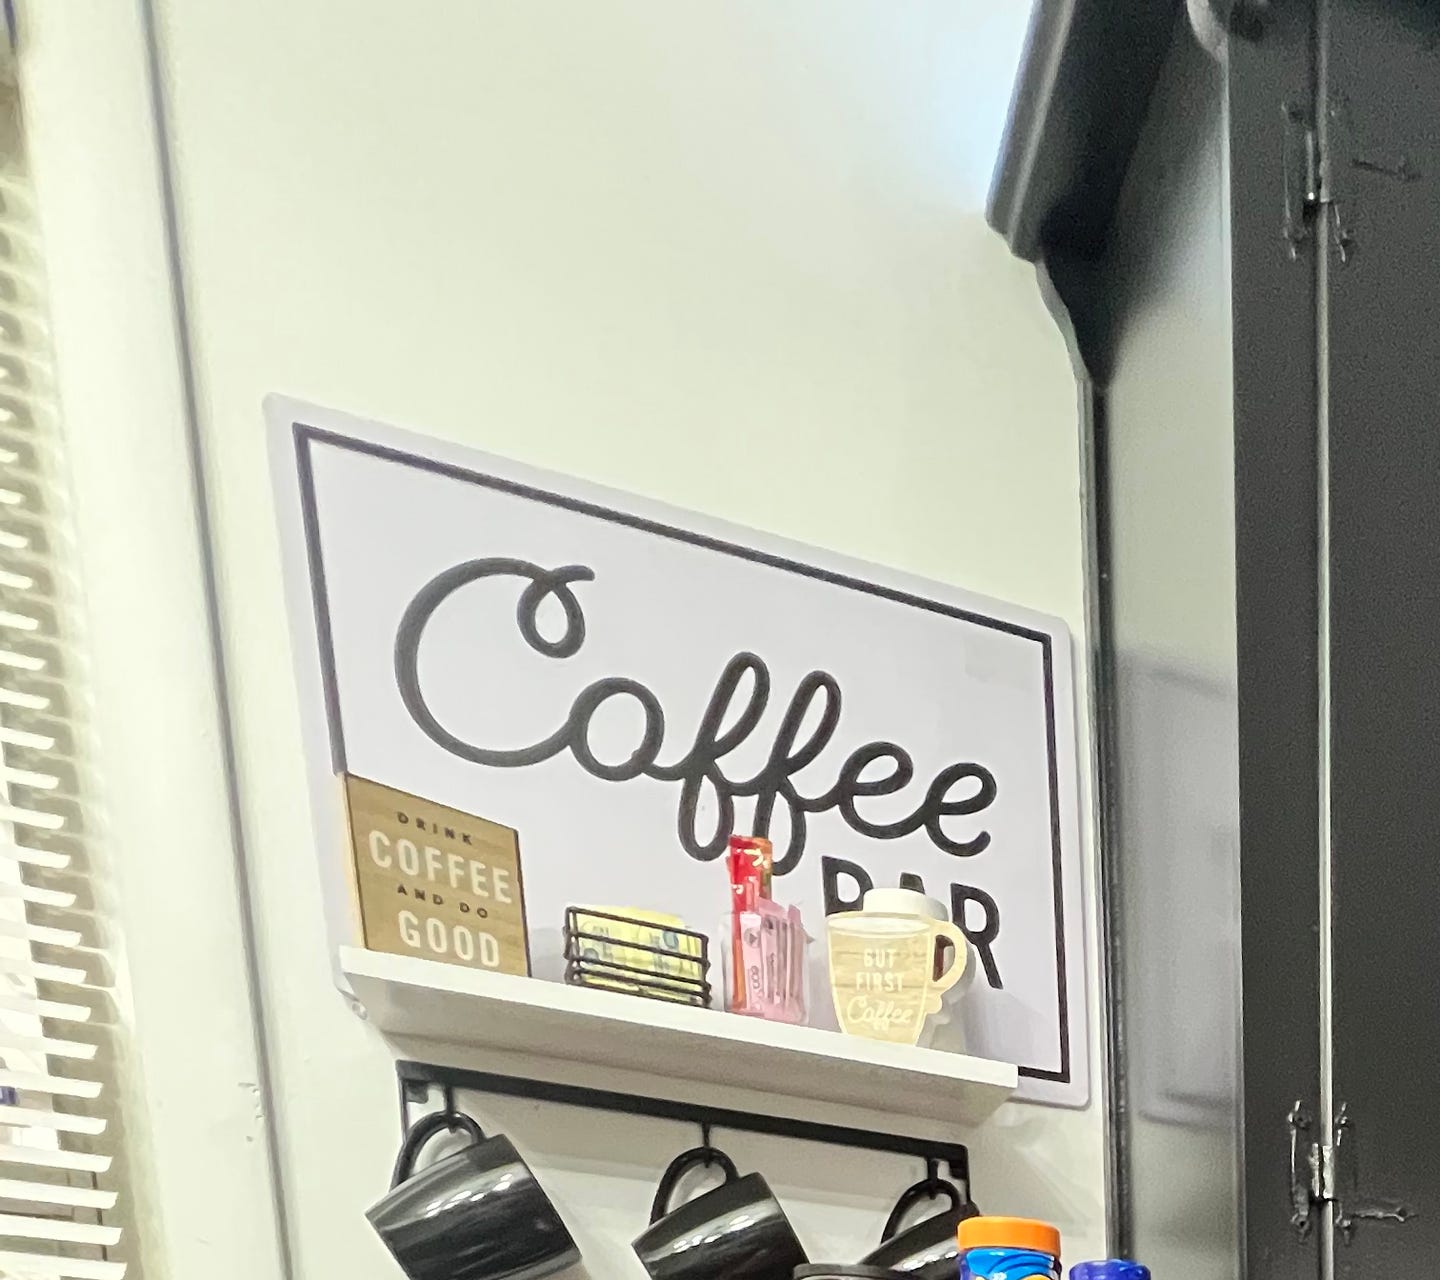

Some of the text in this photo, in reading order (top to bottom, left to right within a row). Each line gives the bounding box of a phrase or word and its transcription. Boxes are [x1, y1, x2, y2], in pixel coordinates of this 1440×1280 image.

[394, 557, 998, 875] Coffee
[396, 812, 473, 846] DRINK
[368, 830, 513, 904] COFFEE
[397, 884, 489, 919] AND DO
[398, 910, 501, 968] GOOD
[862, 946, 897, 967] BUT
[855, 971, 906, 992] FIRST
[847, 995, 914, 1033] Coffee
